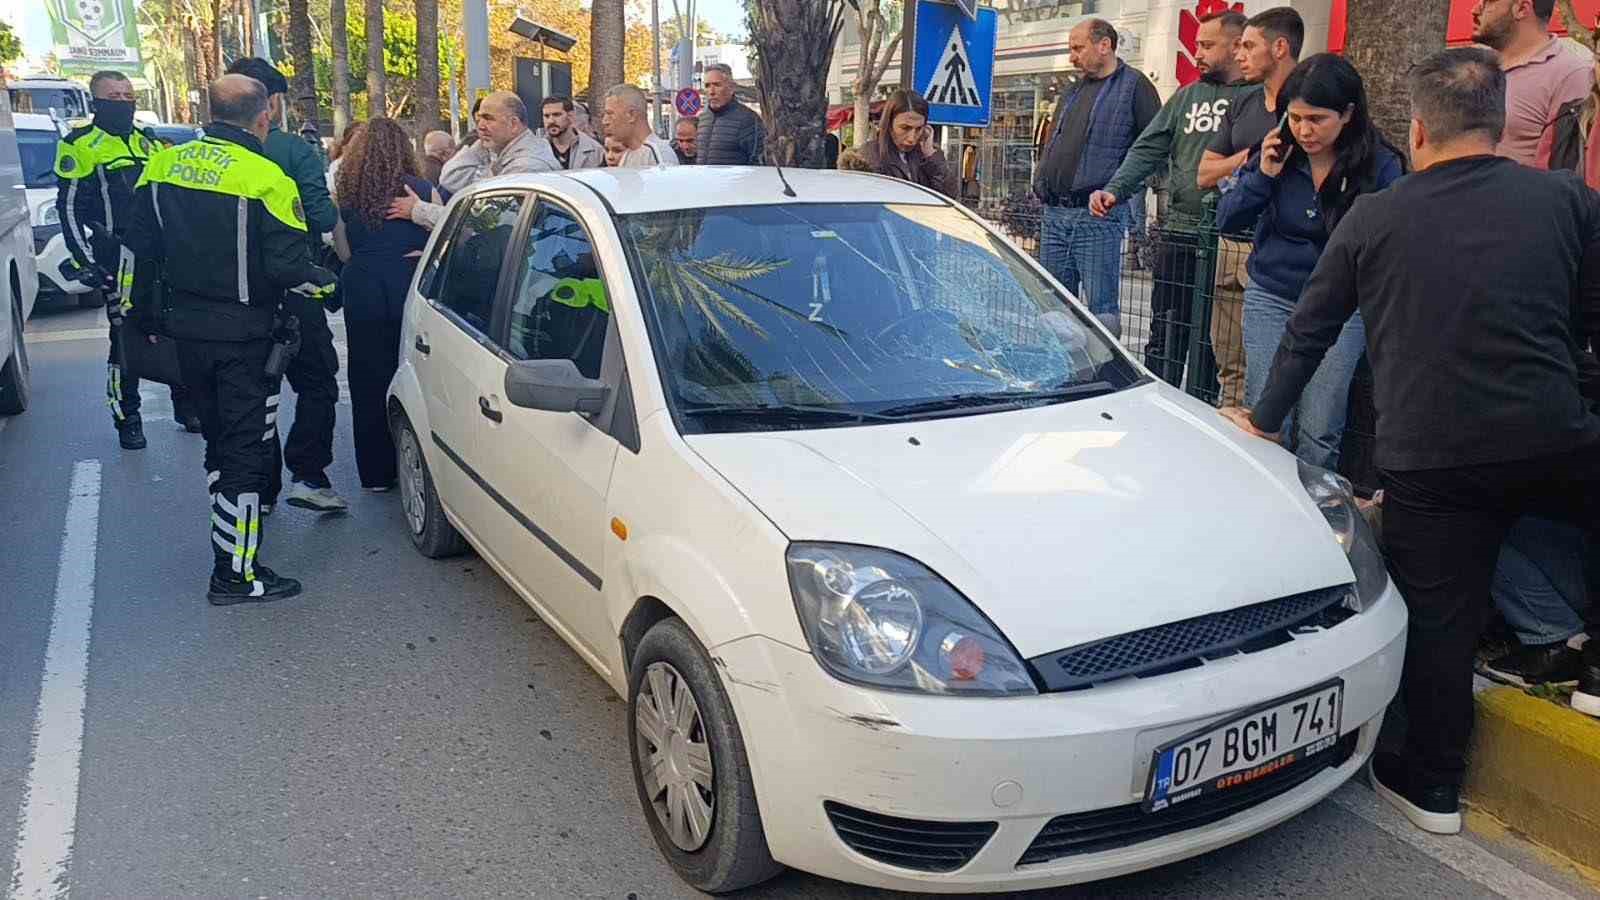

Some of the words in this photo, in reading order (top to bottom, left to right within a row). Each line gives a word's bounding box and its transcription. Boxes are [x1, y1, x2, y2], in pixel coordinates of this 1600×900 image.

[1185, 98, 1232, 119] JAC
[1174, 738, 1212, 786] 07
[1223, 712, 1277, 768] BGM
[1292, 692, 1336, 743] 741
[1216, 774, 1243, 789] OTO
